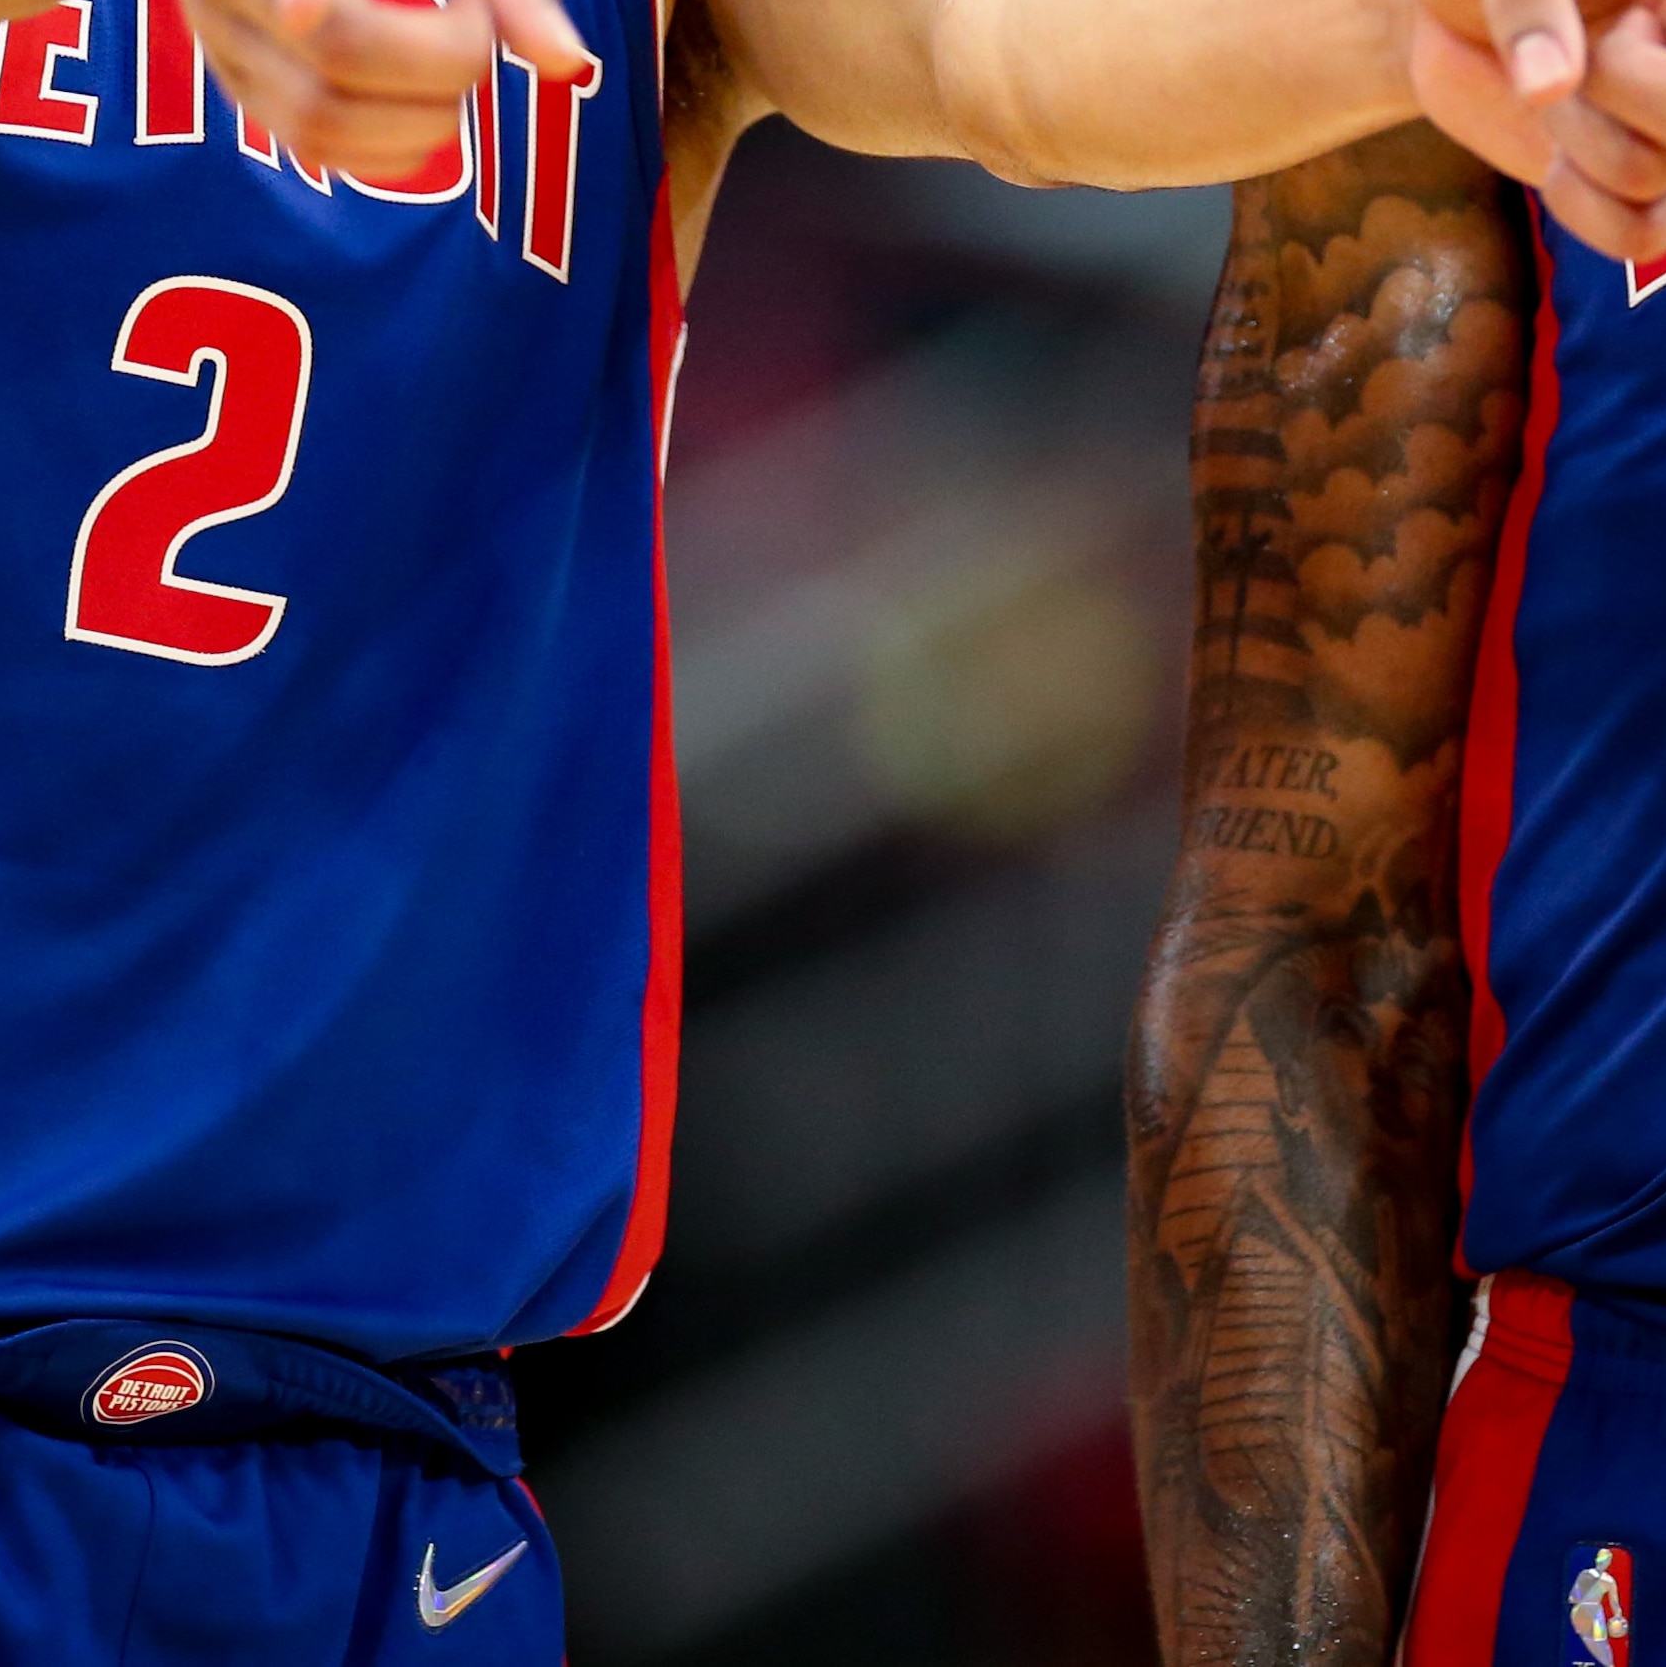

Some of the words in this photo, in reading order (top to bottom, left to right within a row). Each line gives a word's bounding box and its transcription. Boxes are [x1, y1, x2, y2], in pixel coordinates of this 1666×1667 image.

[64, 274, 314, 668] 2
[117, 1378, 192, 1401] DETROIT
[107, 1394, 183, 1412] PISTONS
